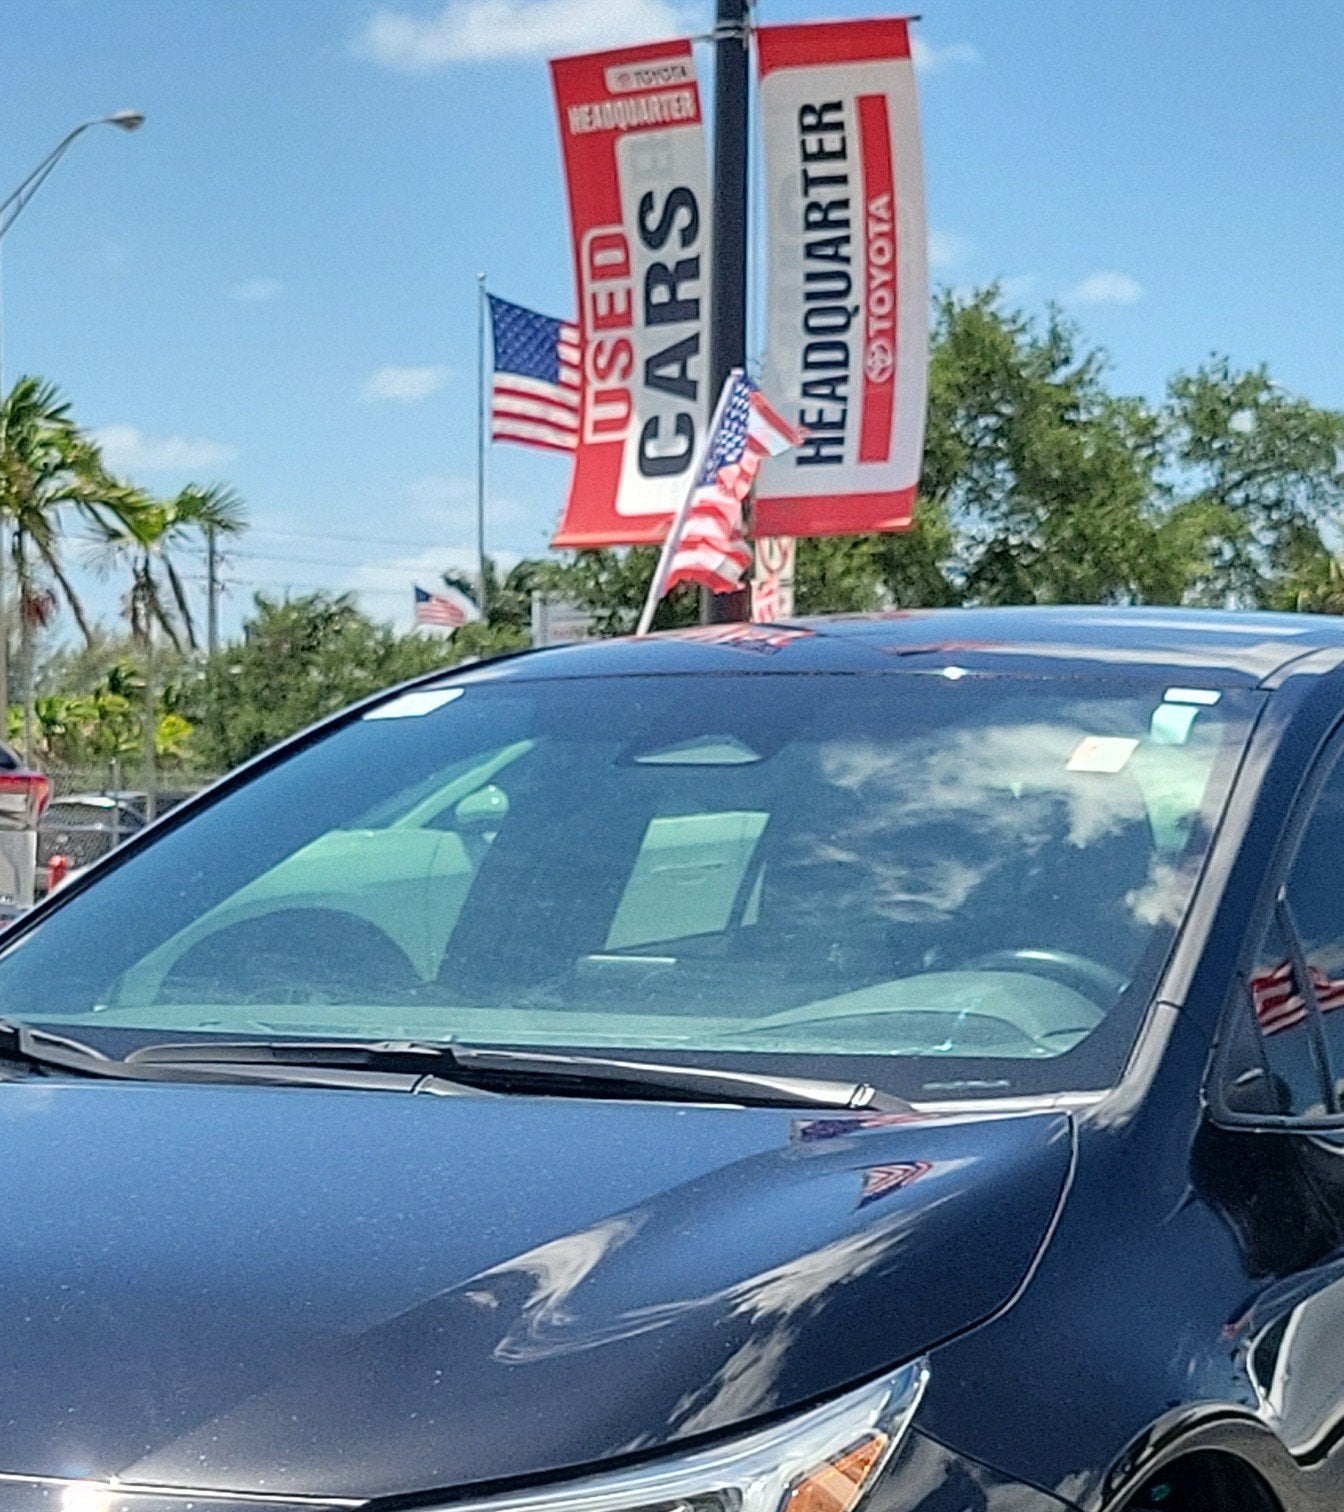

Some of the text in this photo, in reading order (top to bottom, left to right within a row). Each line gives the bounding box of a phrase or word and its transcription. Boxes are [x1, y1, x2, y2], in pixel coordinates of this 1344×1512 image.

[567, 91, 696, 136] HEADQUARTER
[633, 65, 688, 87] TOYOTA
[588, 232, 634, 435] USED
[637, 185, 701, 477] CARS
[796, 100, 860, 466] HEADQUARTER
[867, 191, 895, 339] TOYOTA
